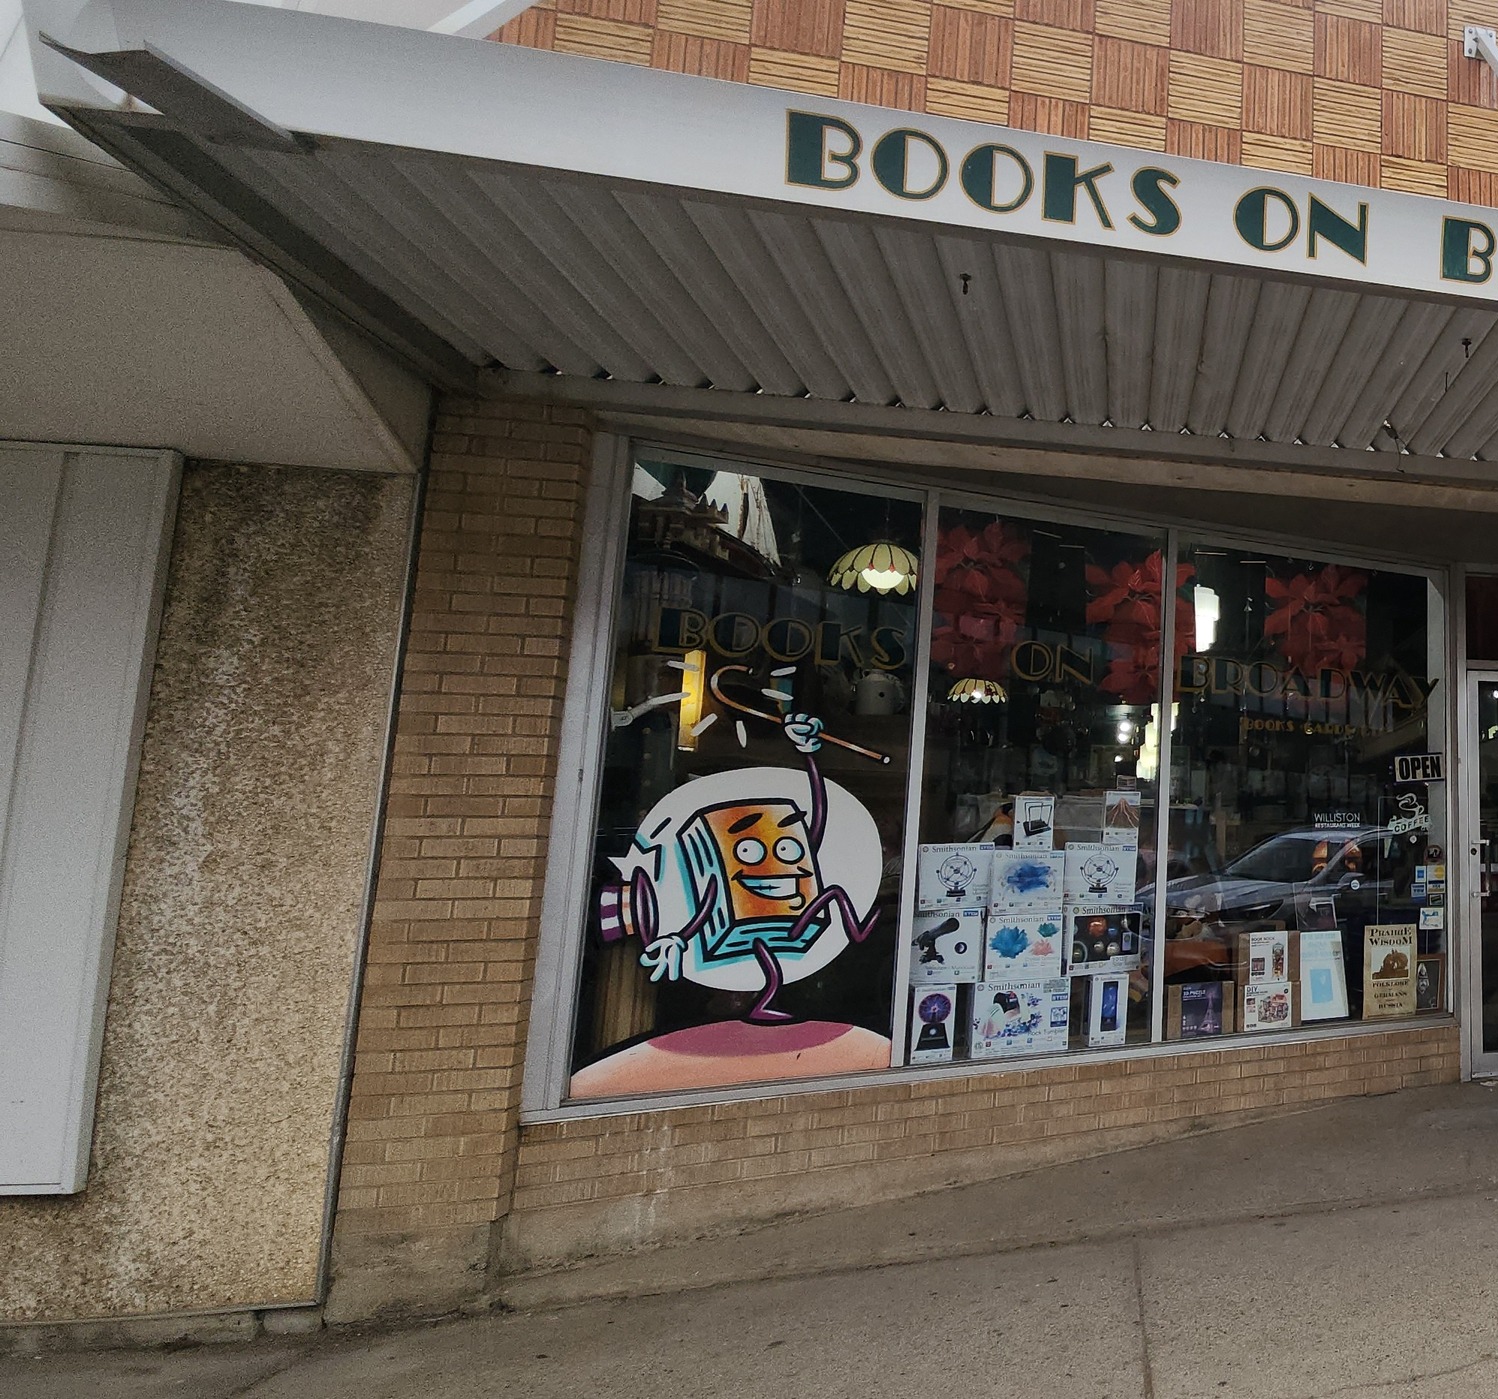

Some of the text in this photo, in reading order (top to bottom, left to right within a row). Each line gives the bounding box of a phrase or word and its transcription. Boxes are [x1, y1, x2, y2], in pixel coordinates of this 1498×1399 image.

[785, 108, 1181, 237] BOOKS
[1233, 186, 1371, 266] ON
[652, 606, 1440, 710] BOOKS ON BROADWAY
[1243, 718, 1295, 732] BOOKS
[1398, 756, 1442, 780] OPEN
[1314, 812, 1361, 823] WILLISTON
[1394, 816, 1429, 833] COFFEE
[931, 845, 977, 854] Smithsonian
[1082, 906, 1126, 914] Smithsonian
[998, 916, 1044, 924] Smithsonian
[988, 983, 1041, 991] Smithsonian
